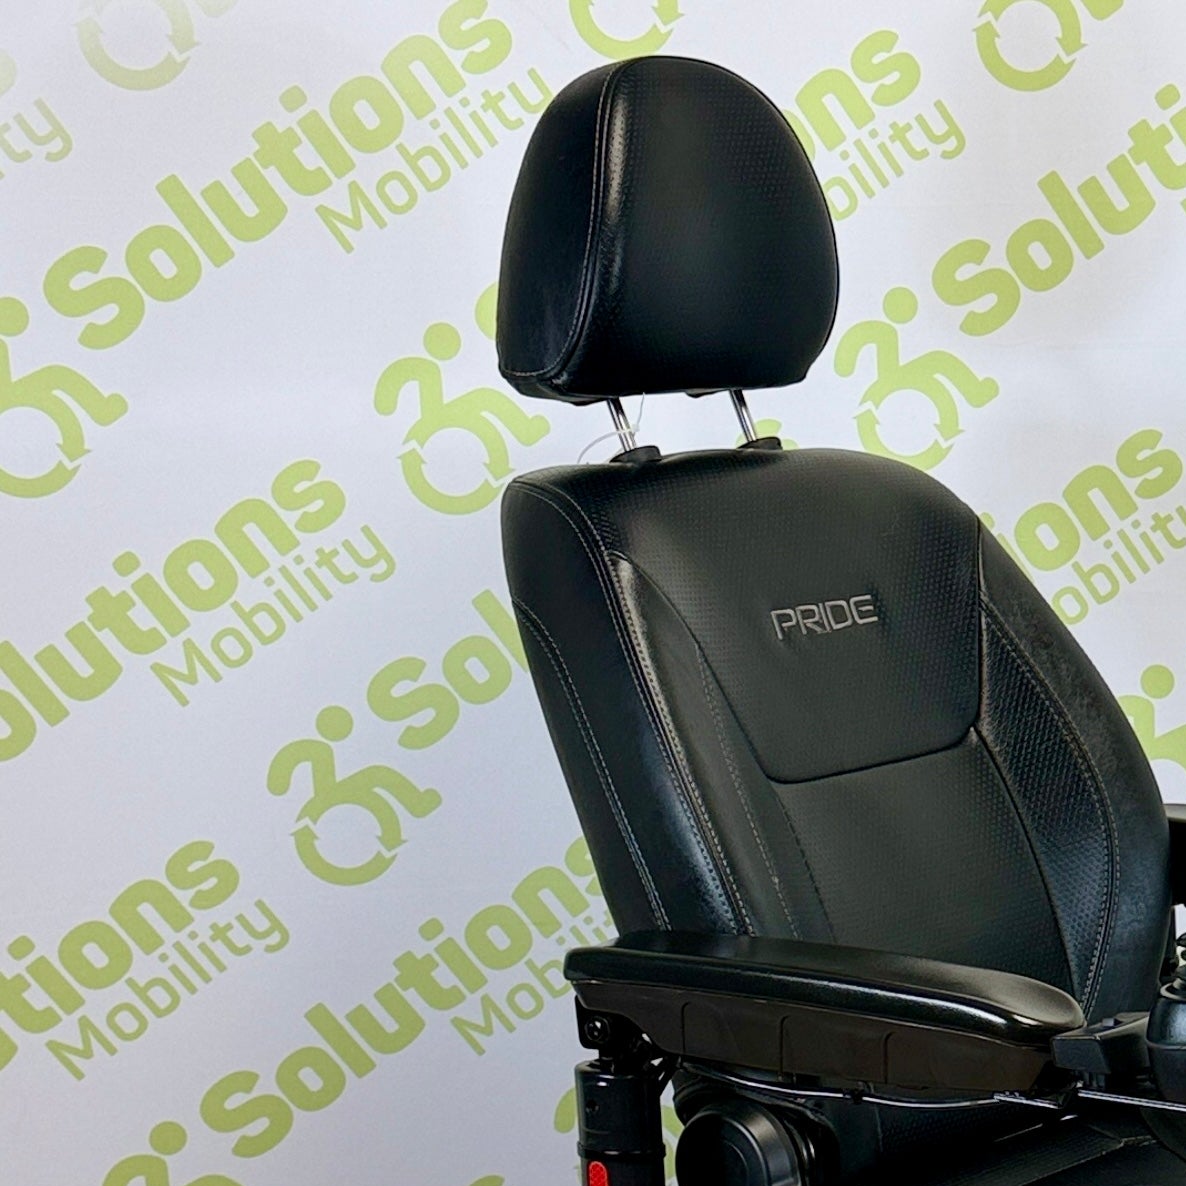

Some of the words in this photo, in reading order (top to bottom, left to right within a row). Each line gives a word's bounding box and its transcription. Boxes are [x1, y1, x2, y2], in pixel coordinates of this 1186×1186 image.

[43, 0, 513, 349] Solutions
[150, 525, 396, 706] Mobility
[771, 595, 878, 640] PRIDE
[45, 899, 290, 1081] Mobility
